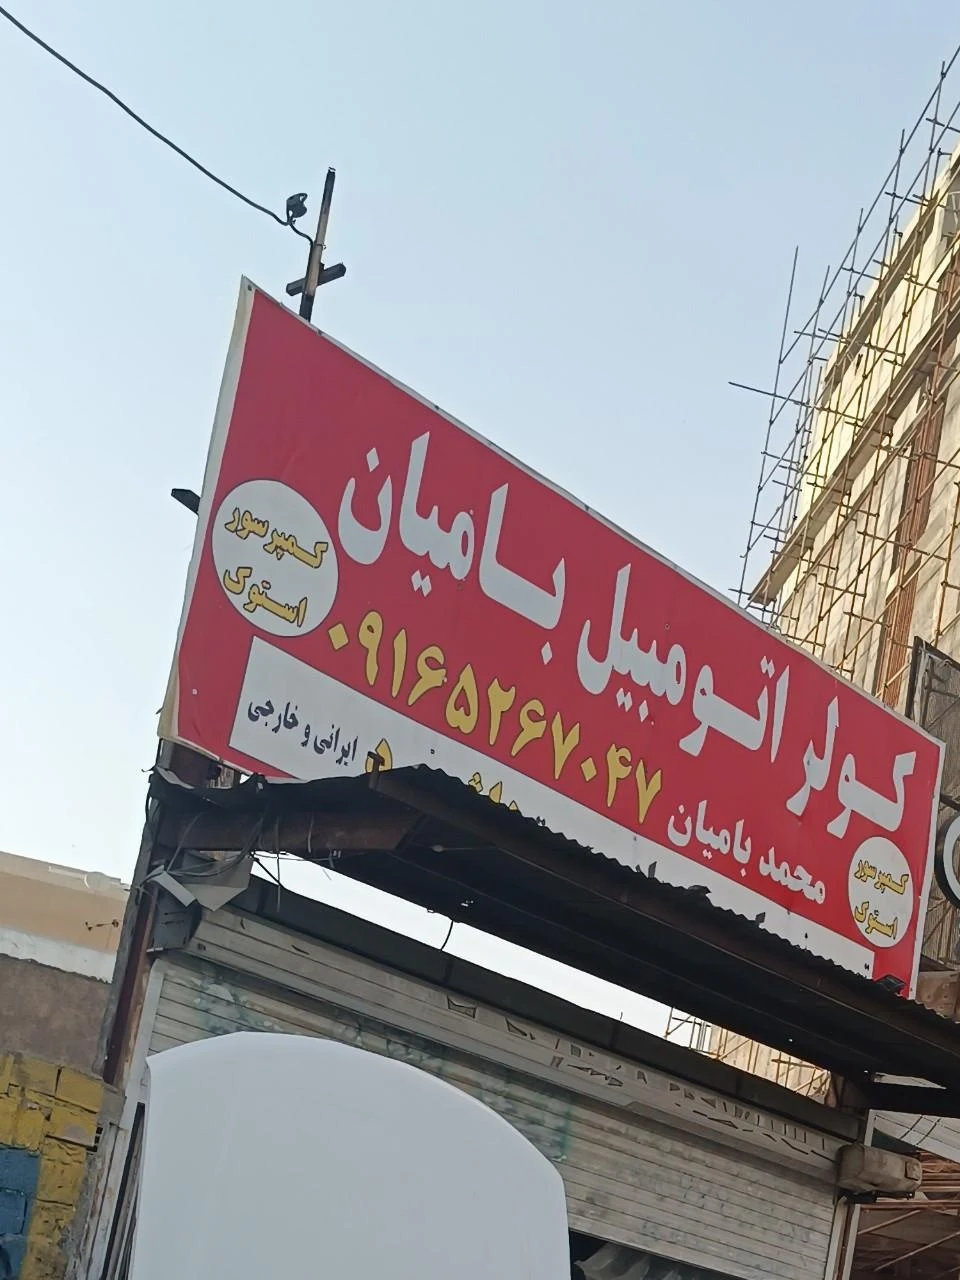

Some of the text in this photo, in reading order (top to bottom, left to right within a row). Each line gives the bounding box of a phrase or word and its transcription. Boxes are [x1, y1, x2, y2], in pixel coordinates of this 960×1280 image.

[223, 566, 308, 627] استوک
[338, 431, 917, 839] کولر اتومبیل بامیان
[247, 699, 299, 733] خارجی
[301, 723, 311, 748] و
[327, 610, 663, 824] ۰۹۱۶۵۲۶۷۰۴۷
[313, 723, 359, 766] ایرانی
[667, 799, 826, 905] محمد بامیان
[854, 901, 899, 940] استوک
